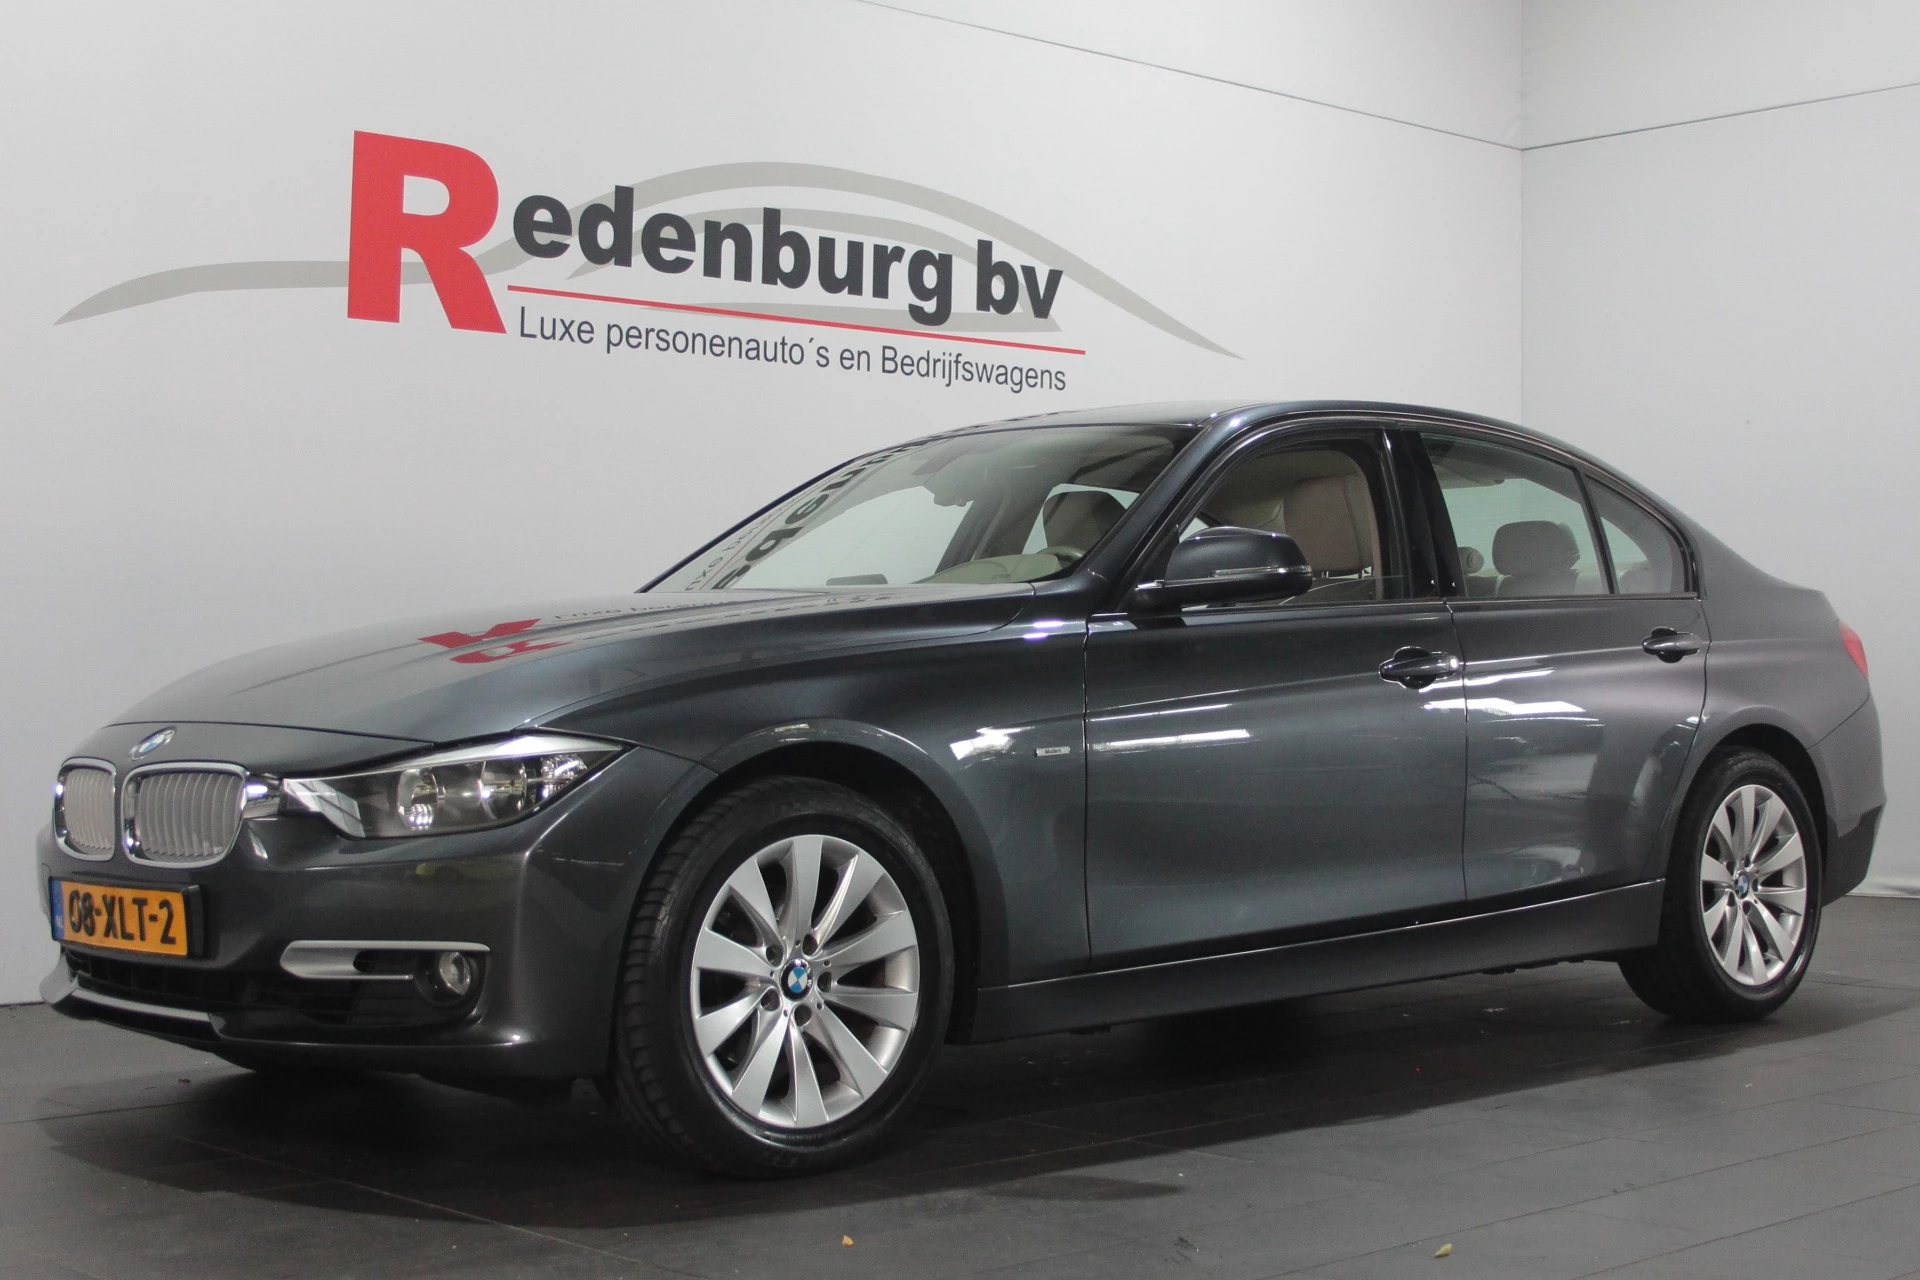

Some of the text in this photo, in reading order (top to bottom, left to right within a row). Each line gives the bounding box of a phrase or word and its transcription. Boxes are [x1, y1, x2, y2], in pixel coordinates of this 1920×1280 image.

[348, 131, 1064, 334] Redenburg bv
[520, 306, 595, 345] Luxe
[839, 348, 871, 372] en
[881, 345, 1066, 394] Bedrijfswagens
[68, 889, 176, 945] 08-XLT-2
